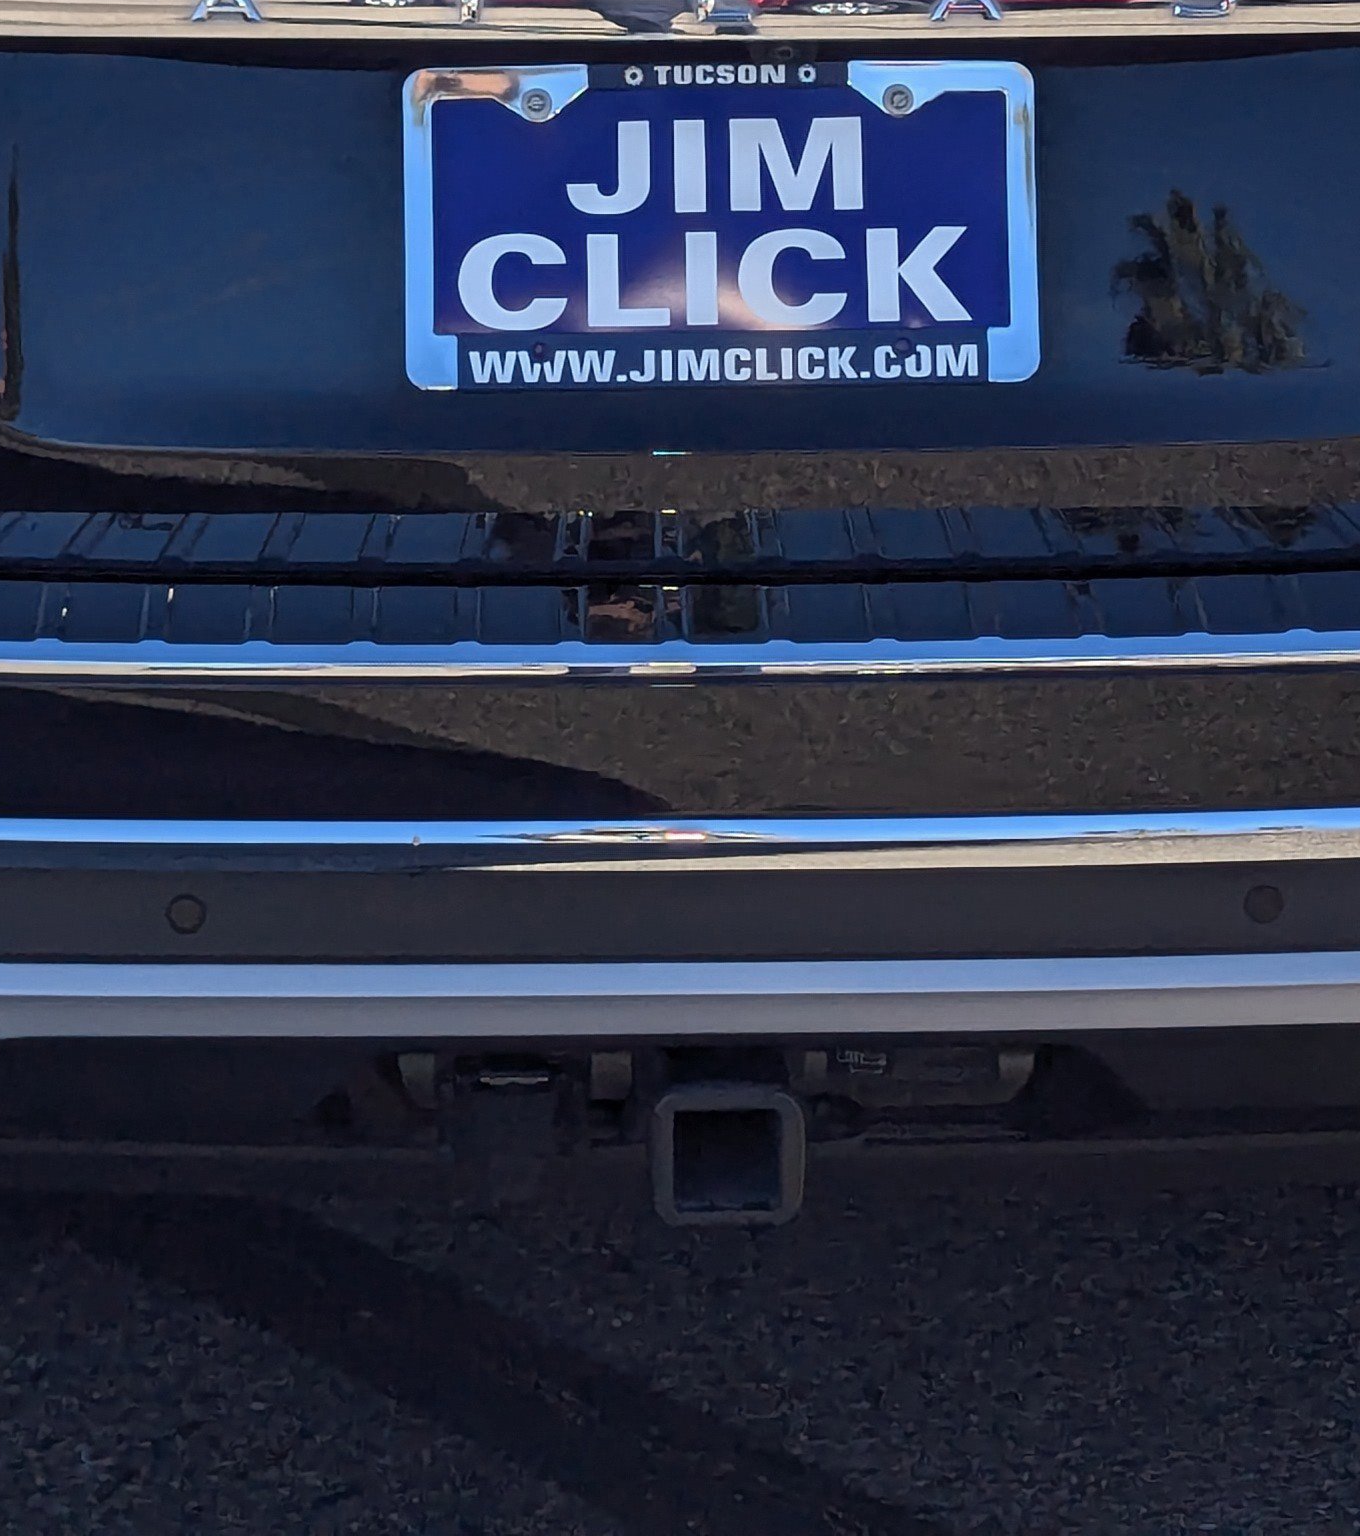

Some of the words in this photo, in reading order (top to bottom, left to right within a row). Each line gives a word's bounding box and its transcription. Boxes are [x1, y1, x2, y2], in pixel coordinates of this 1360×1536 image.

[653, 64, 786, 86] TUCSON
[566, 116, 865, 215] JIM
[457, 226, 973, 331] CLICK
[468, 343, 980, 384] WWW.JIMCLICK.COM
